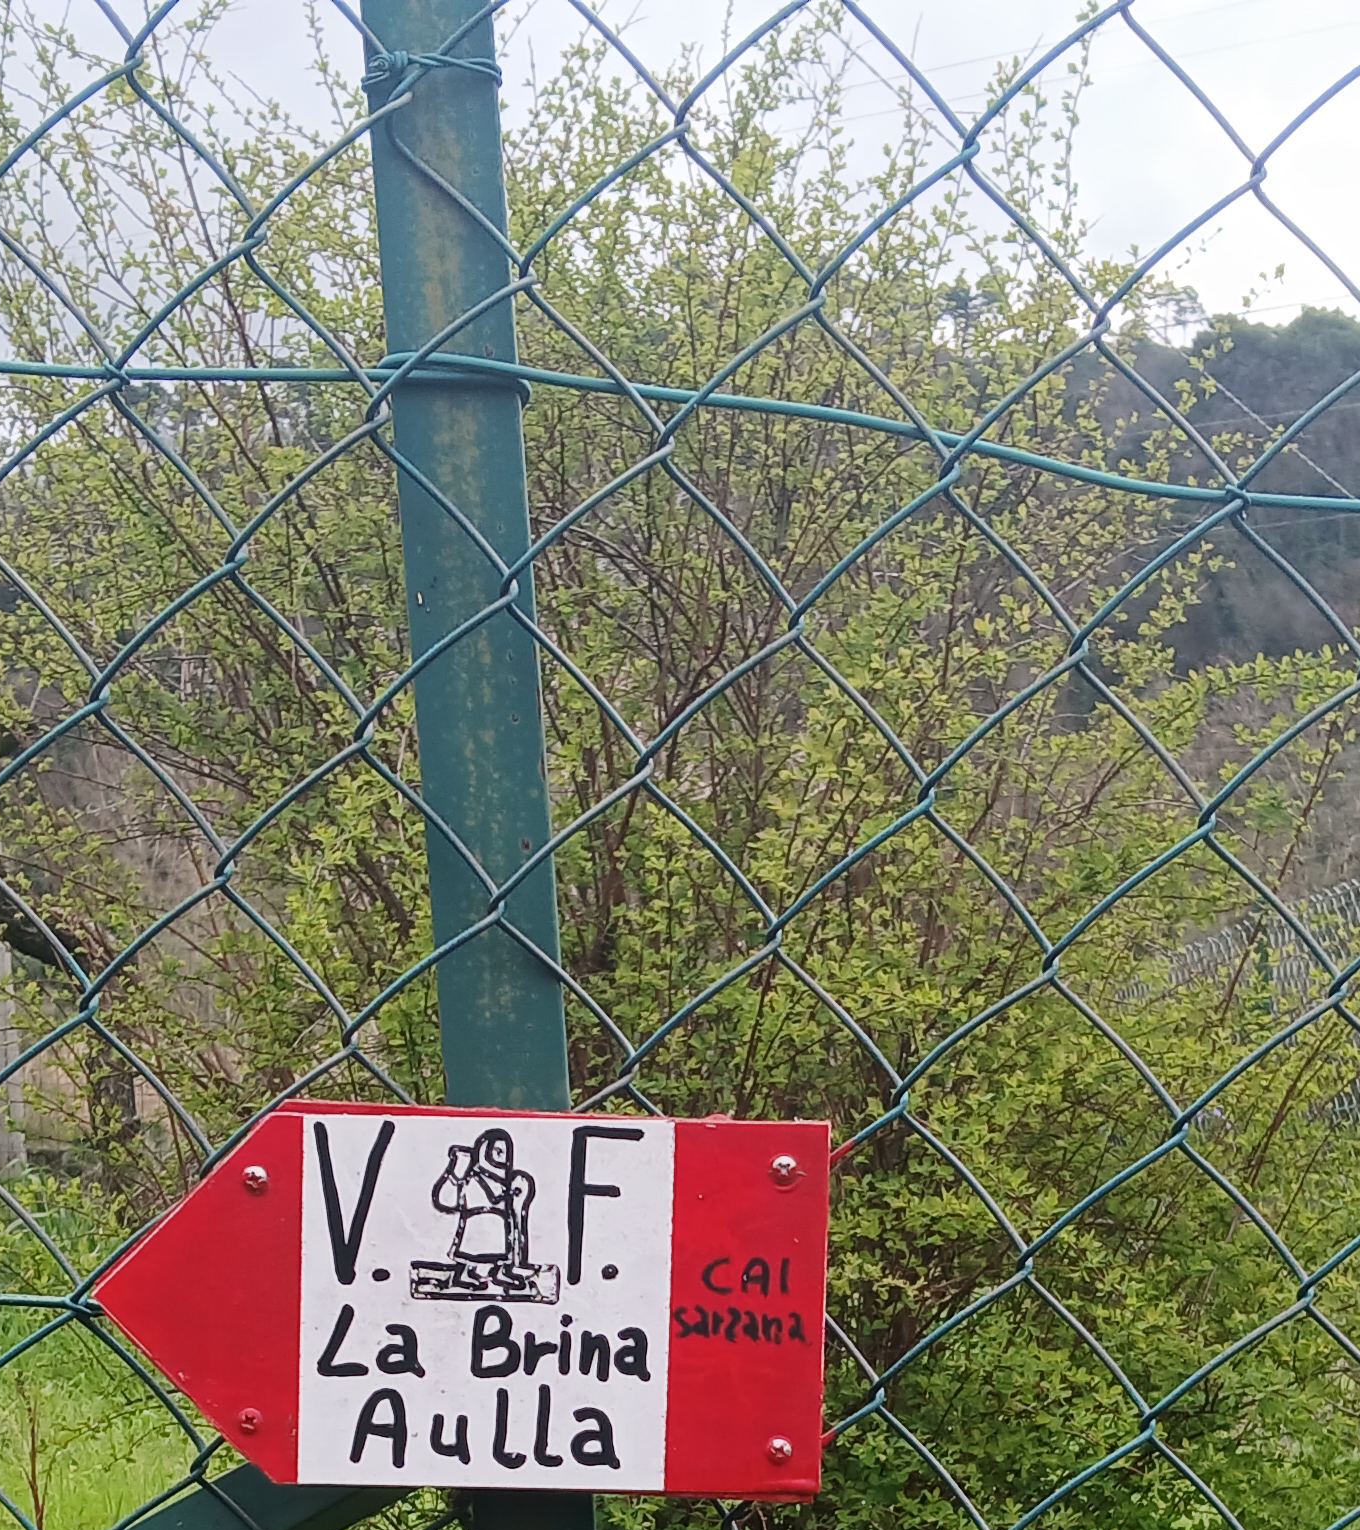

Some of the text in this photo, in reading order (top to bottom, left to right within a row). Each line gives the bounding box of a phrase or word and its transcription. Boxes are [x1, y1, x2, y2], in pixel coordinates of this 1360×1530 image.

[313, 1120, 645, 1286] V. F.
[701, 1257, 790, 1298] CAI
[316, 1304, 651, 1383] La Brina
[349, 1383, 621, 1470] Aulla
